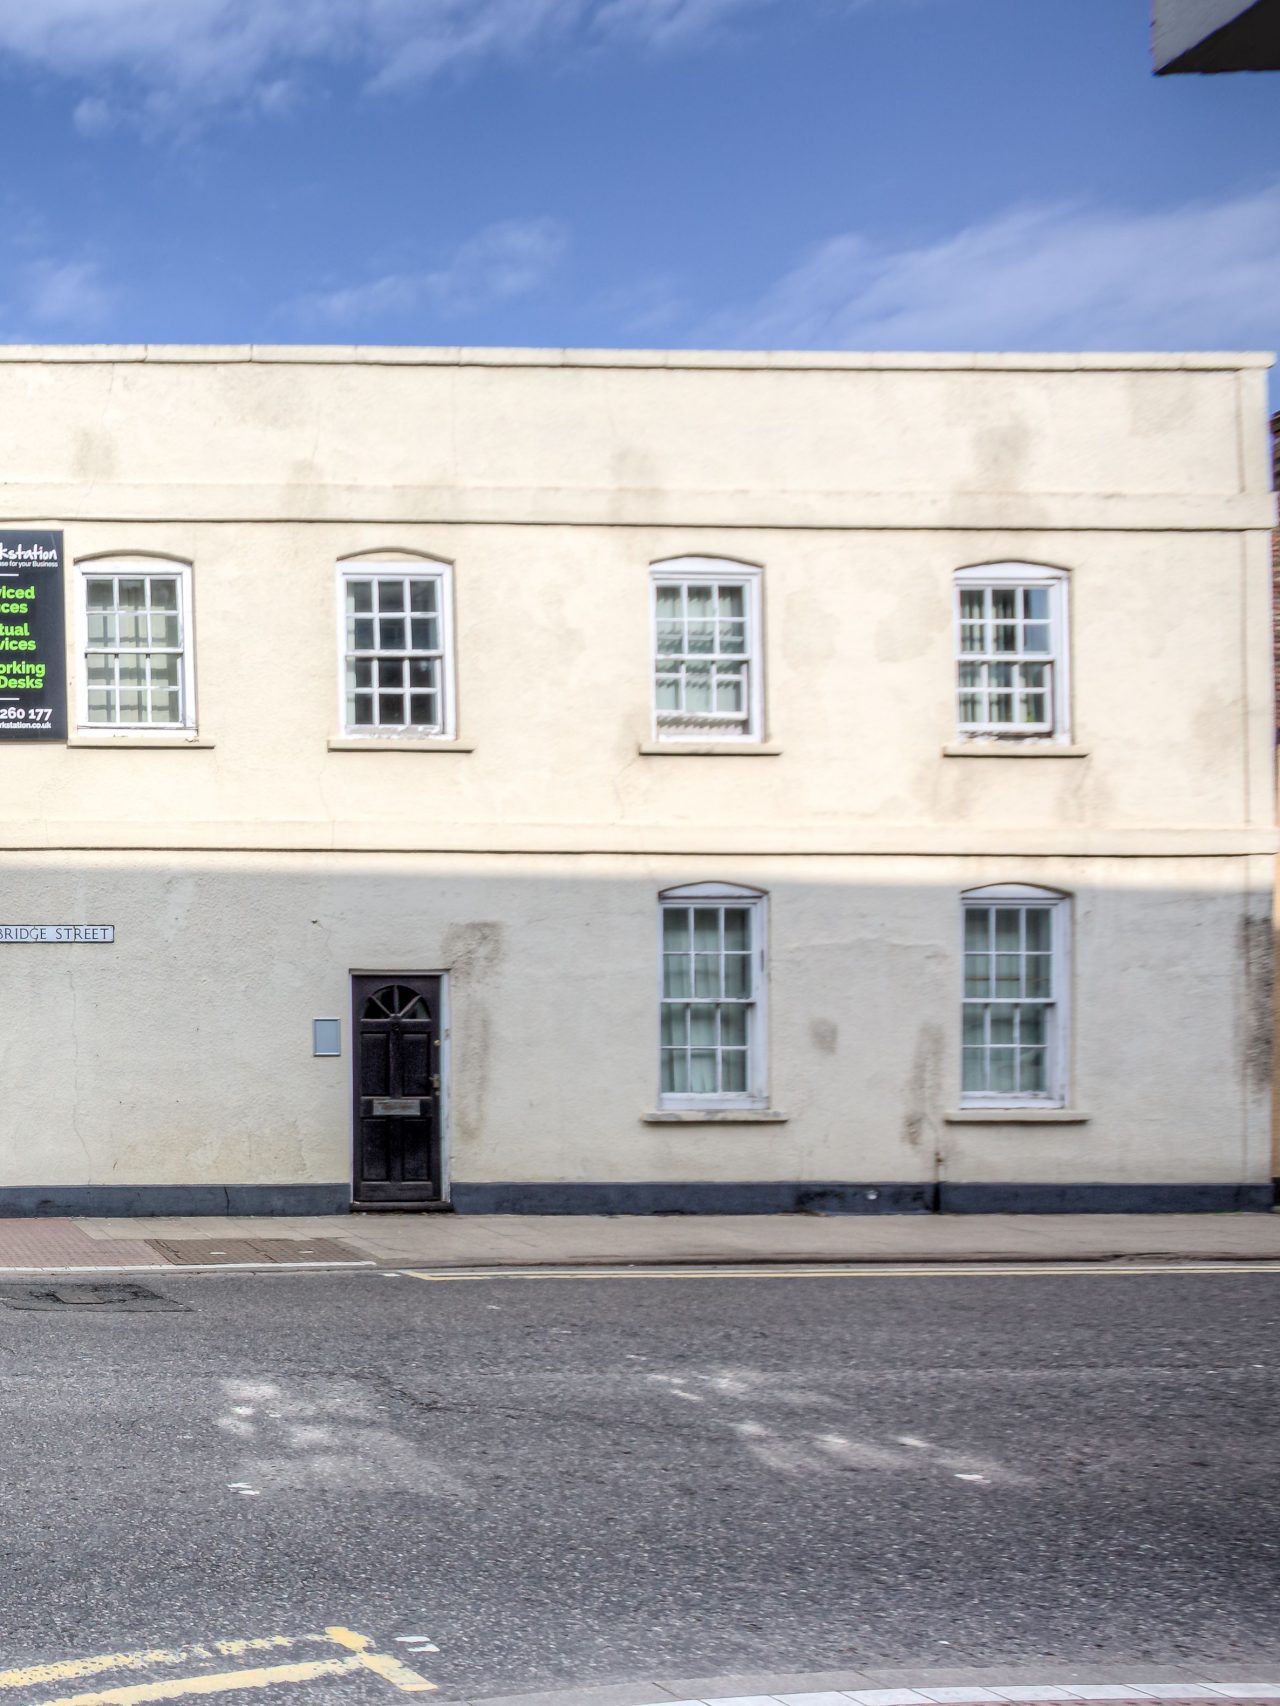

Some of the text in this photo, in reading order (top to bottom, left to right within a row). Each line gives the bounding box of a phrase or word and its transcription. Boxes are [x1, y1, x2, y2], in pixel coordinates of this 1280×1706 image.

[0, 706, 26, 719] 260
[28, 708, 53, 721] 177
[55, 927, 109, 940] STREET
